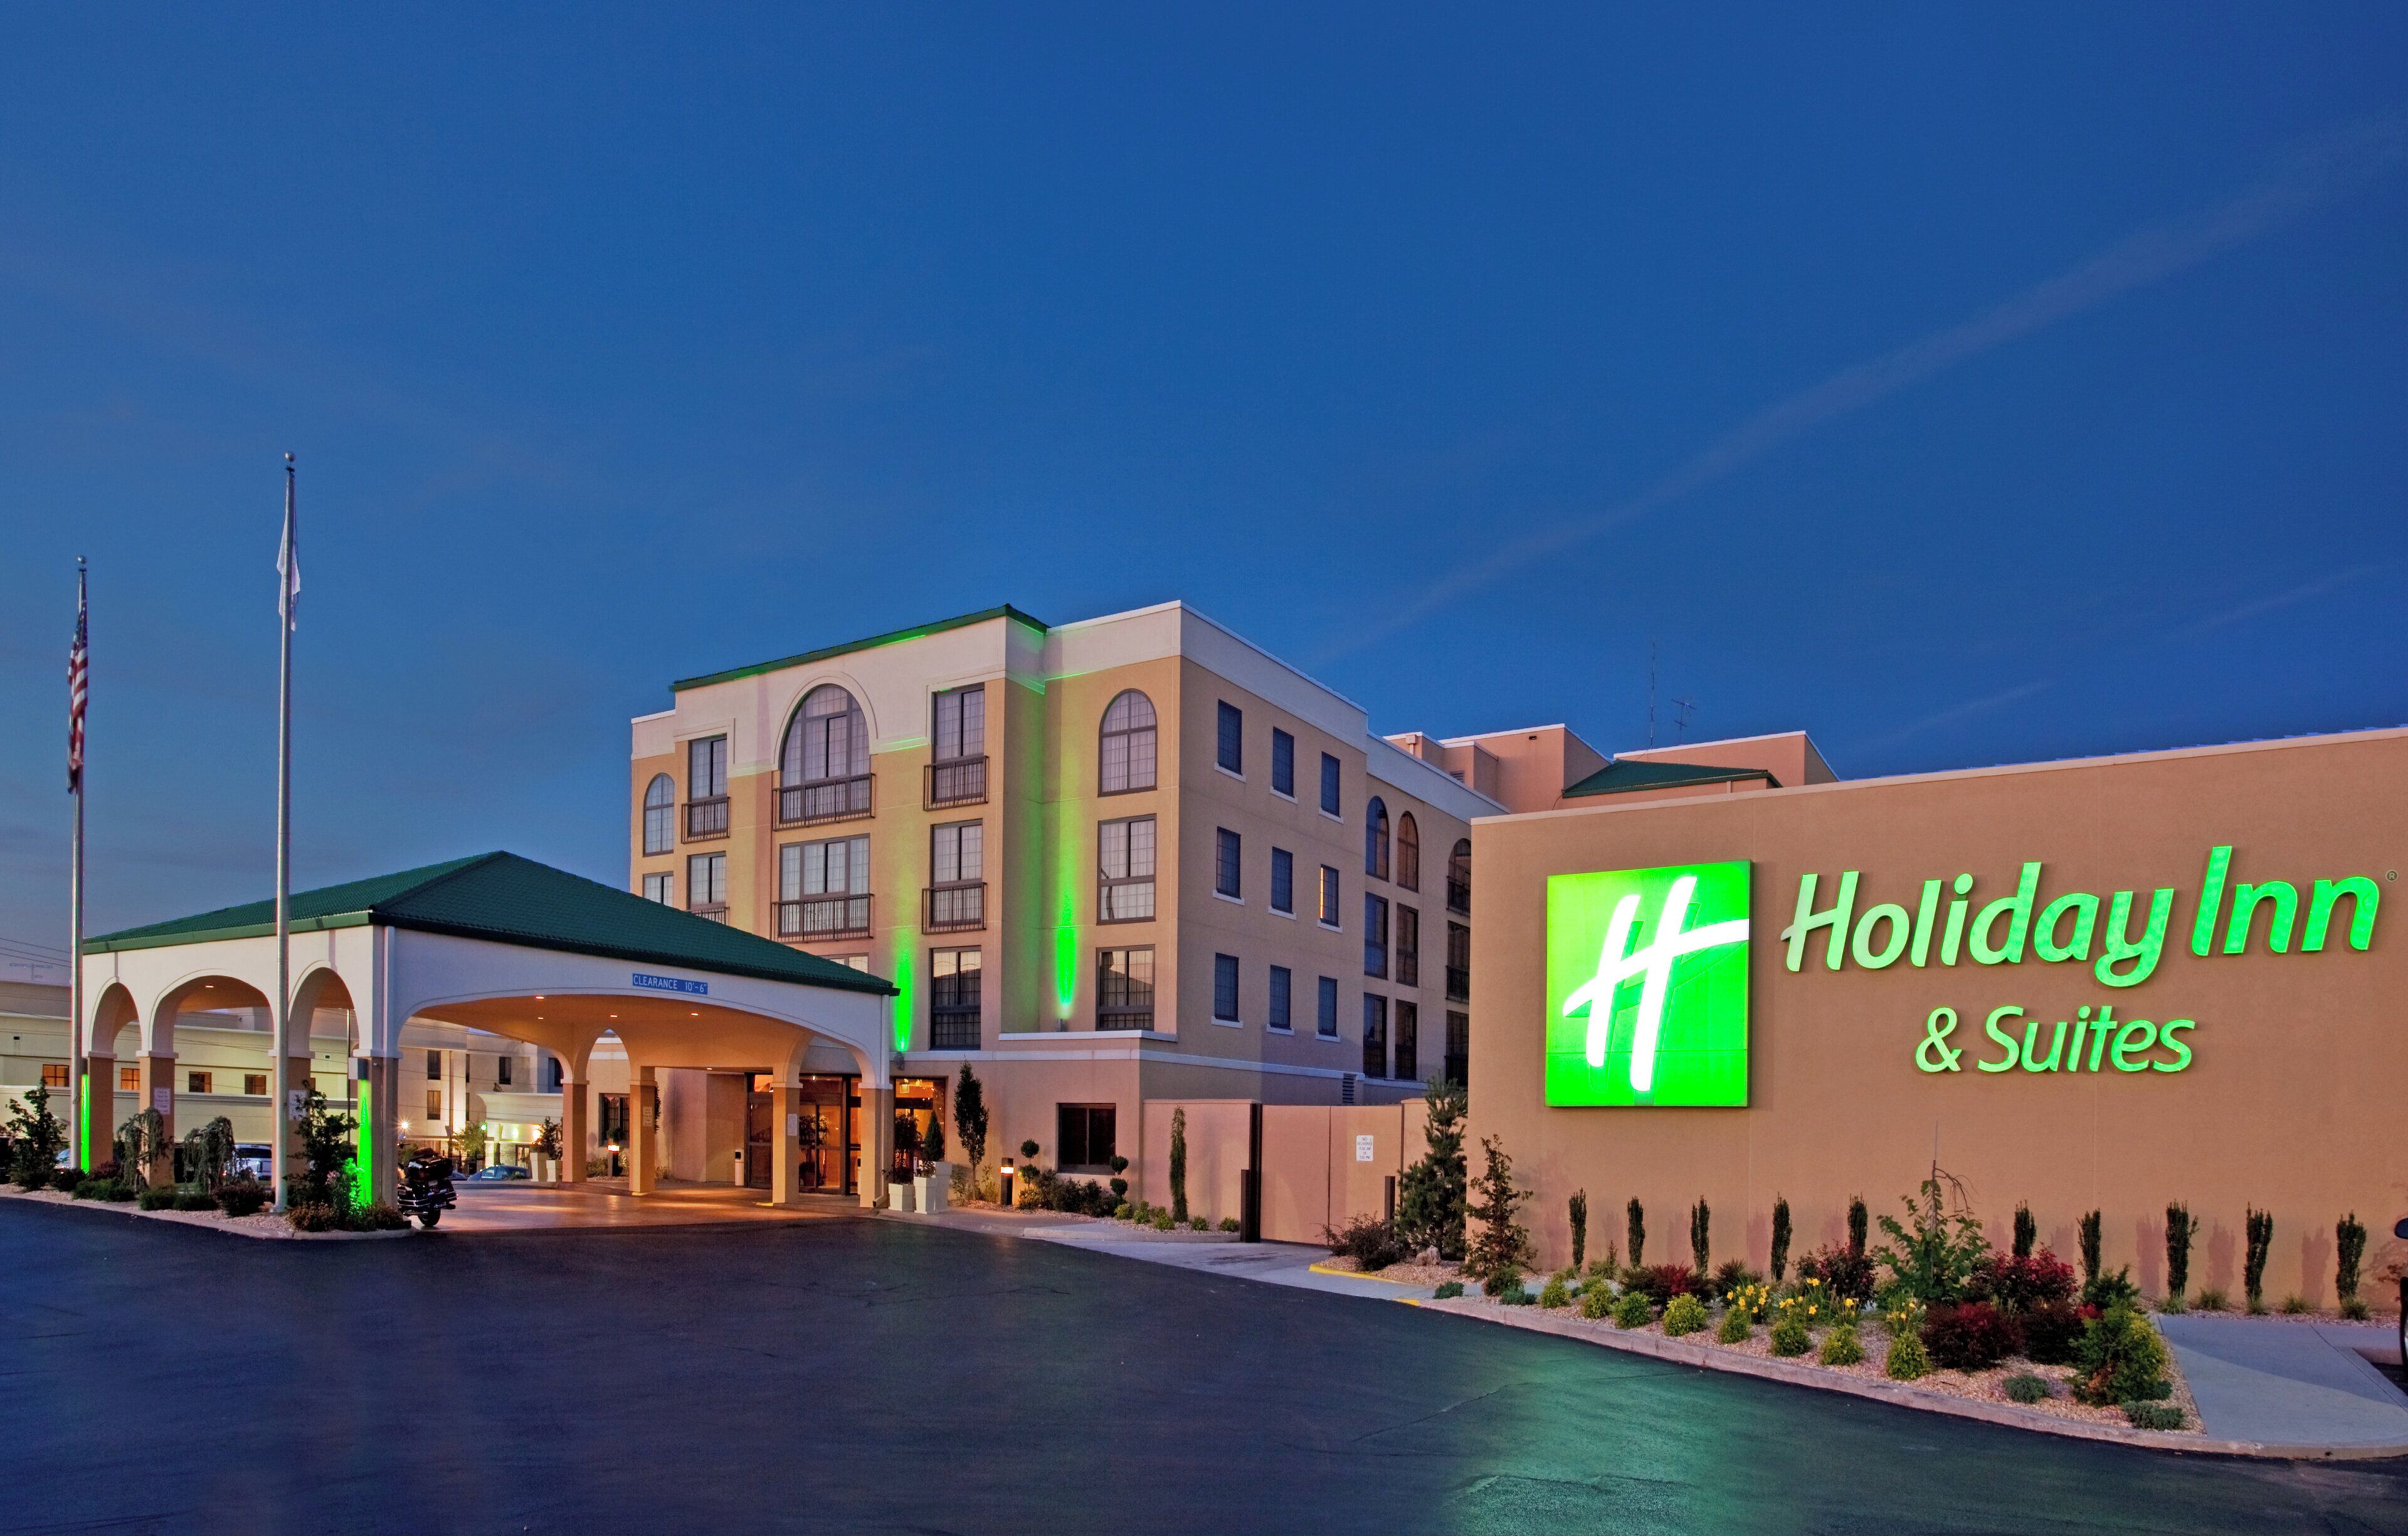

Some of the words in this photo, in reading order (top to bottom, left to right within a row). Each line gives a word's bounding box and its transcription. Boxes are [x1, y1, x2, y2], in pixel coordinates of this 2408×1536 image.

[1780, 861, 2175, 988] Holiday
[2189, 844, 2382, 958] Inn
[633, 975, 678, 990] CLEARANCE
[1914, 1006, 1963, 1073] &
[1977, 1005, 2197, 1073] Suites
